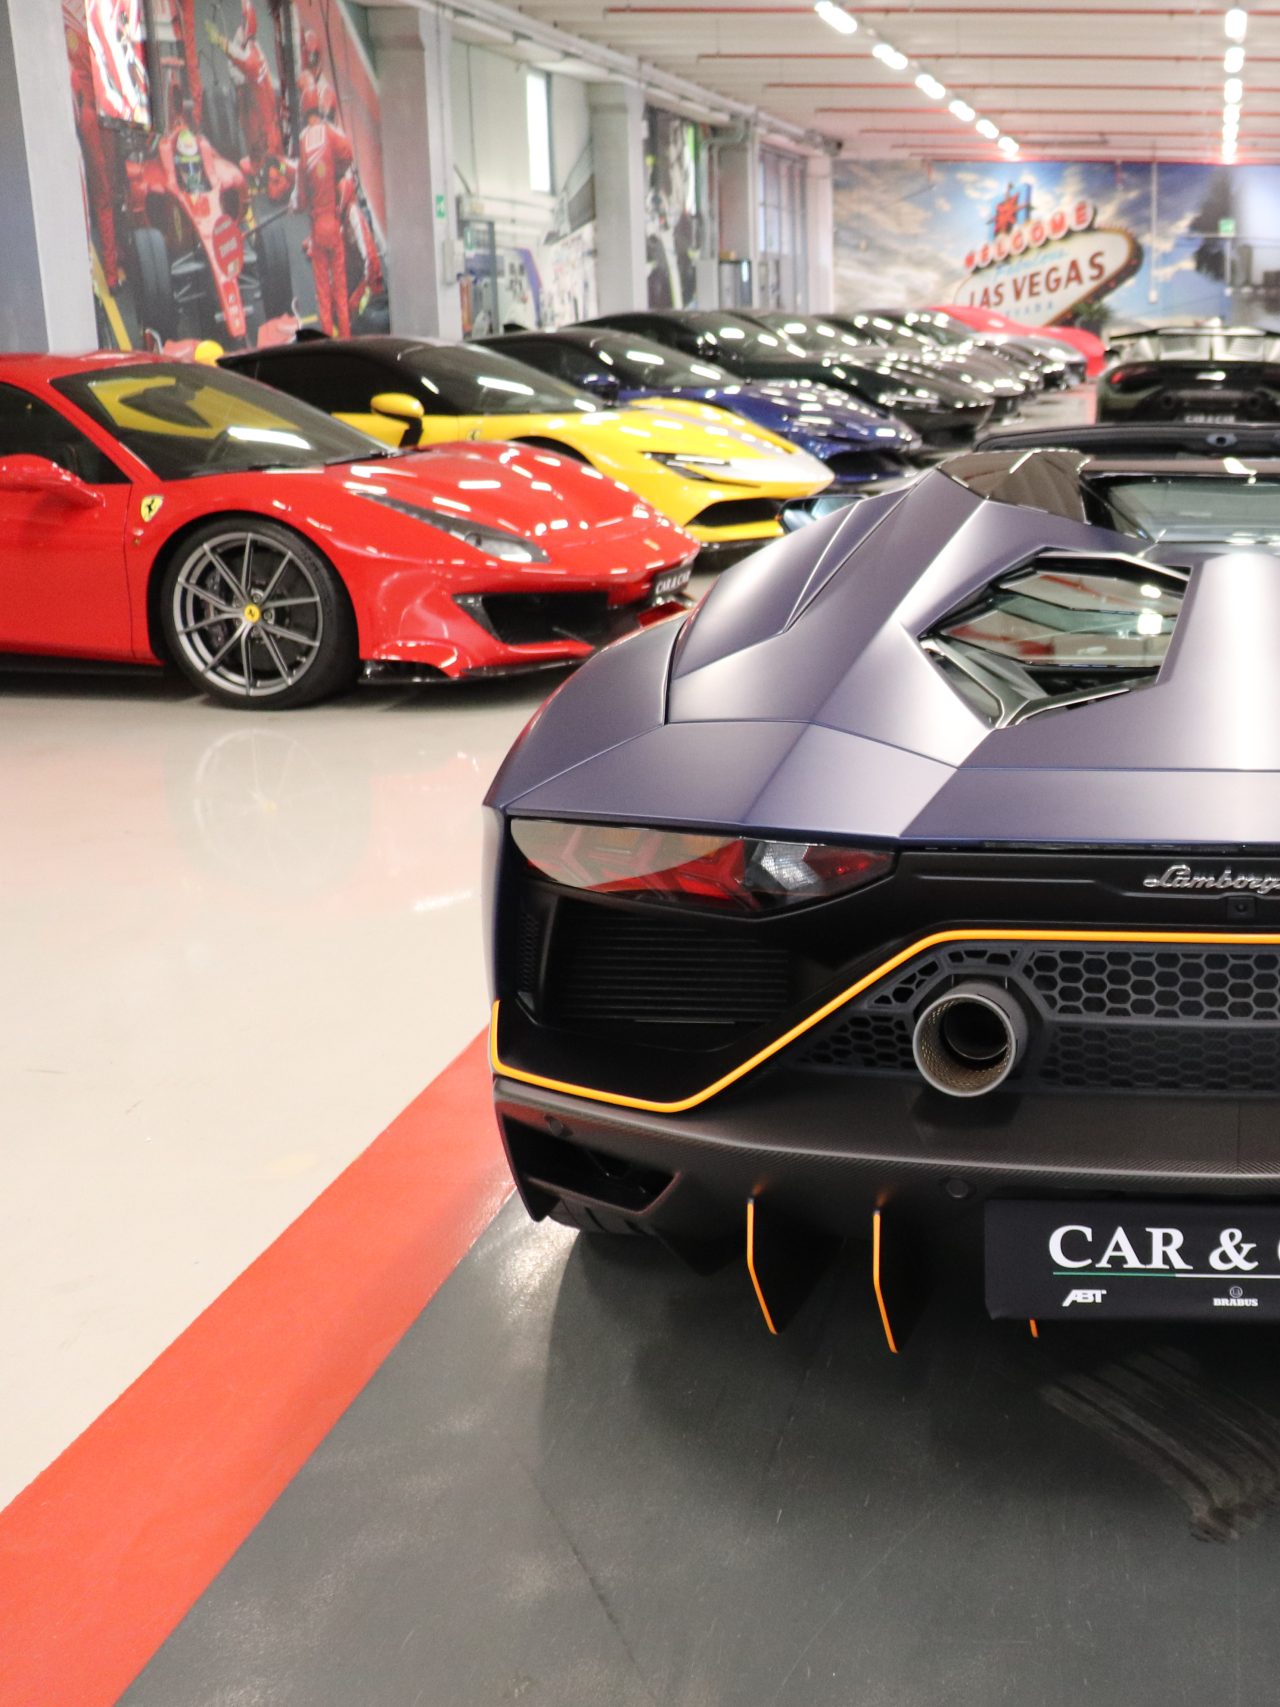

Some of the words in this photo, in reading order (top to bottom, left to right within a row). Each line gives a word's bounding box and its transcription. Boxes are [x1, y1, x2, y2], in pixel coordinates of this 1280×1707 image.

[969, 282, 1004, 309] LAS
[1012, 252, 1105, 301] VEGAS
[1048, 1224, 1193, 1270] CAR
[1208, 1228, 1259, 1271] &
[1062, 1289, 1107, 1307] ABT
[1213, 1298, 1259, 1306] BRABUS
